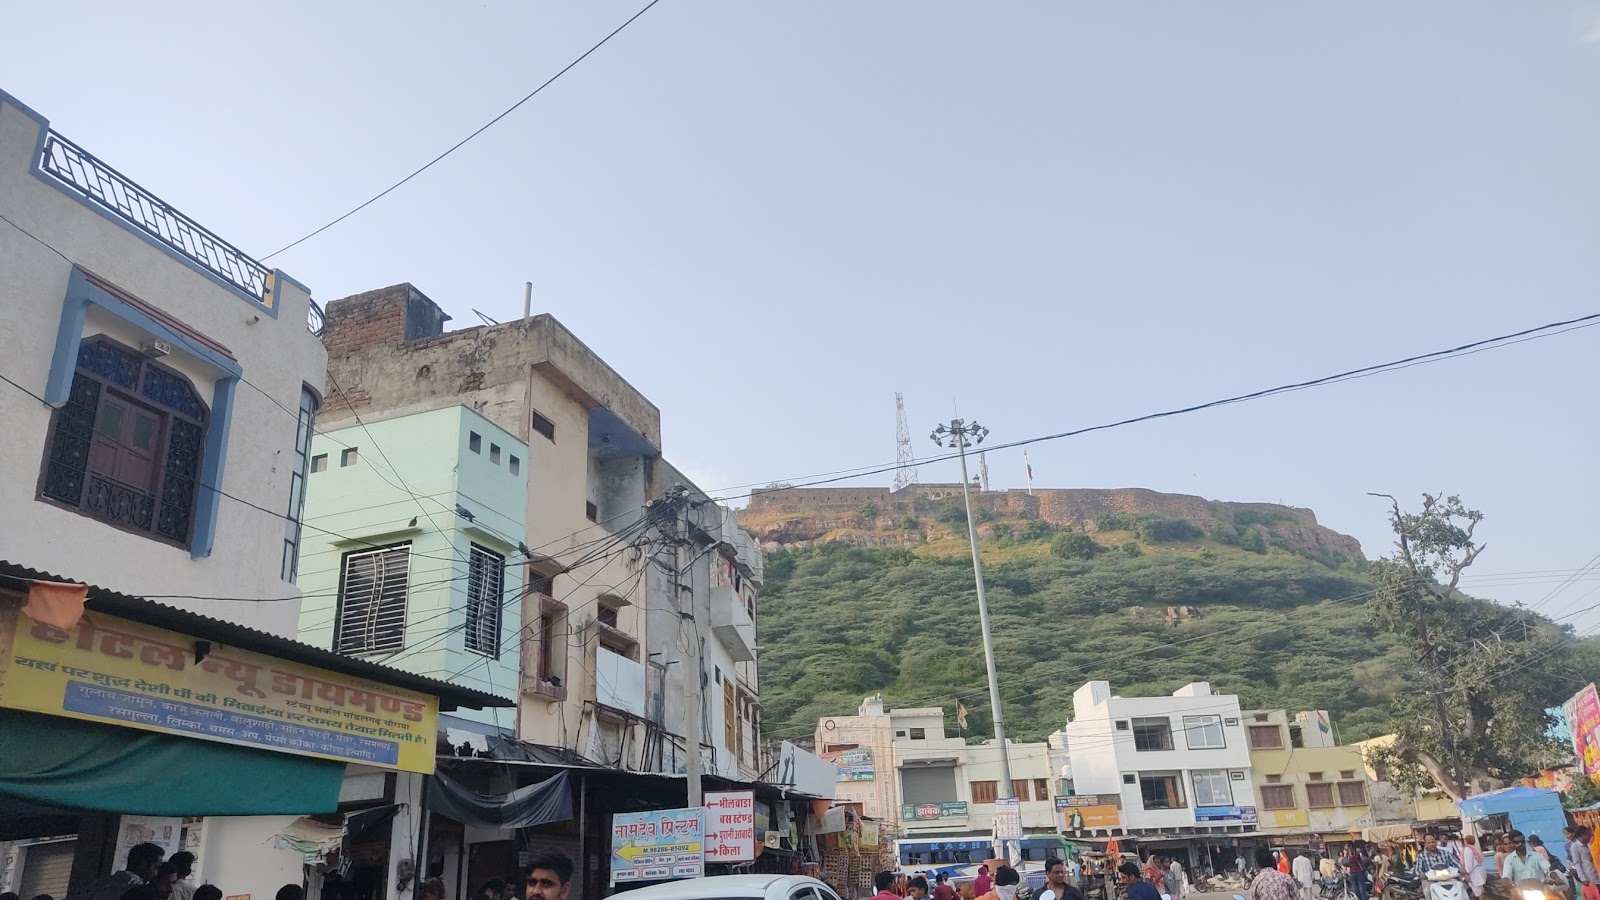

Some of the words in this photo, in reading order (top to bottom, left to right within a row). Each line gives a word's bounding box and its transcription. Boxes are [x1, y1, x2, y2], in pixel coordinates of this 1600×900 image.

[79, 685, 116, 700] गुलाब
[202, 654, 267, 699] न्यू
[271, 668, 426, 722] डायमण्ड
[61, 664, 90, 678] पर
[92, 671, 131, 688] शुद्ध
[134, 678, 172, 695] देशी
[173, 687, 193, 700] घी
[195, 692, 217, 704] की
[286, 711, 305, 721] हर
[307, 714, 342, 729] समय
[345, 719, 378, 734] तैयार
[378, 727, 413, 742] मिलती
[719, 814, 732, 825] बस
[733, 812, 752, 824] स्टेण्ड
[615, 817, 657, 840] नामदेव
[661, 813, 701, 837] प्रिन्टर्स
[719, 828, 734, 843] पुरानी
[734, 828, 752, 839] आबादी
[719, 844, 741, 857] किला
